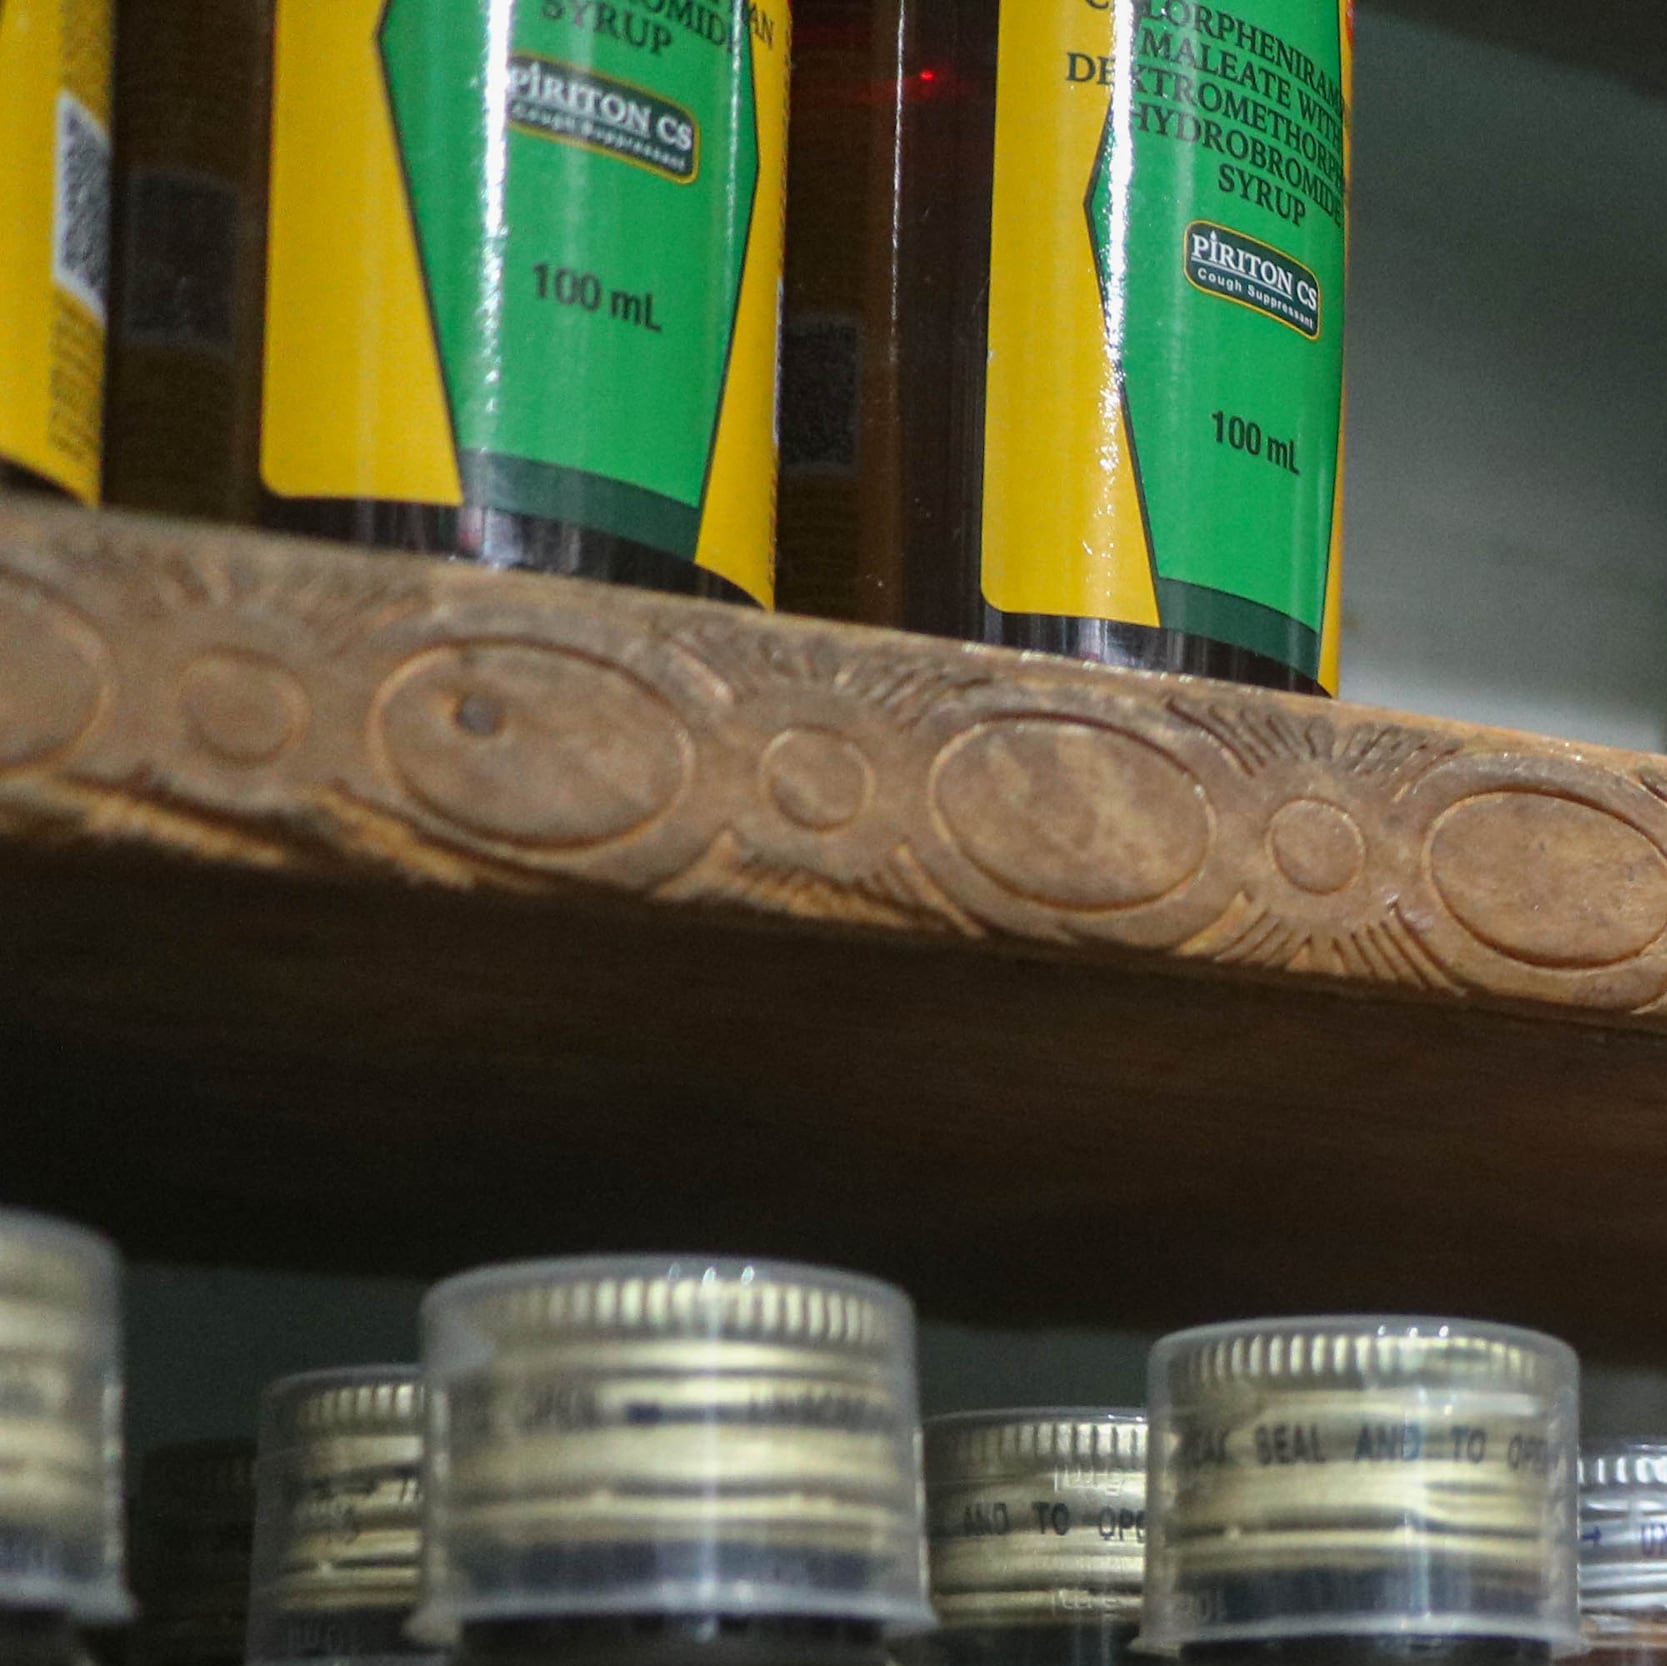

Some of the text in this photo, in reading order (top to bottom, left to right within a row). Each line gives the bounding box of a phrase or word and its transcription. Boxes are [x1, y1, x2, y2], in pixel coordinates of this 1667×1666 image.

[1141, 28, 1292, 109] MALEATE
[656, 113, 692, 151] CS
[1218, 163, 1306, 227] SYRUP
[532, 262, 662, 332] 100 mL
[1191, 230, 1318, 312] PIRITON CS
[1197, 266, 1314, 331] Cough Suppressant
[1211, 409, 1300, 476] 100 mL
[1355, 1421, 1424, 1463] AND
[1450, 1424, 1487, 1463] TO
[1032, 1501, 1069, 1537] TO
